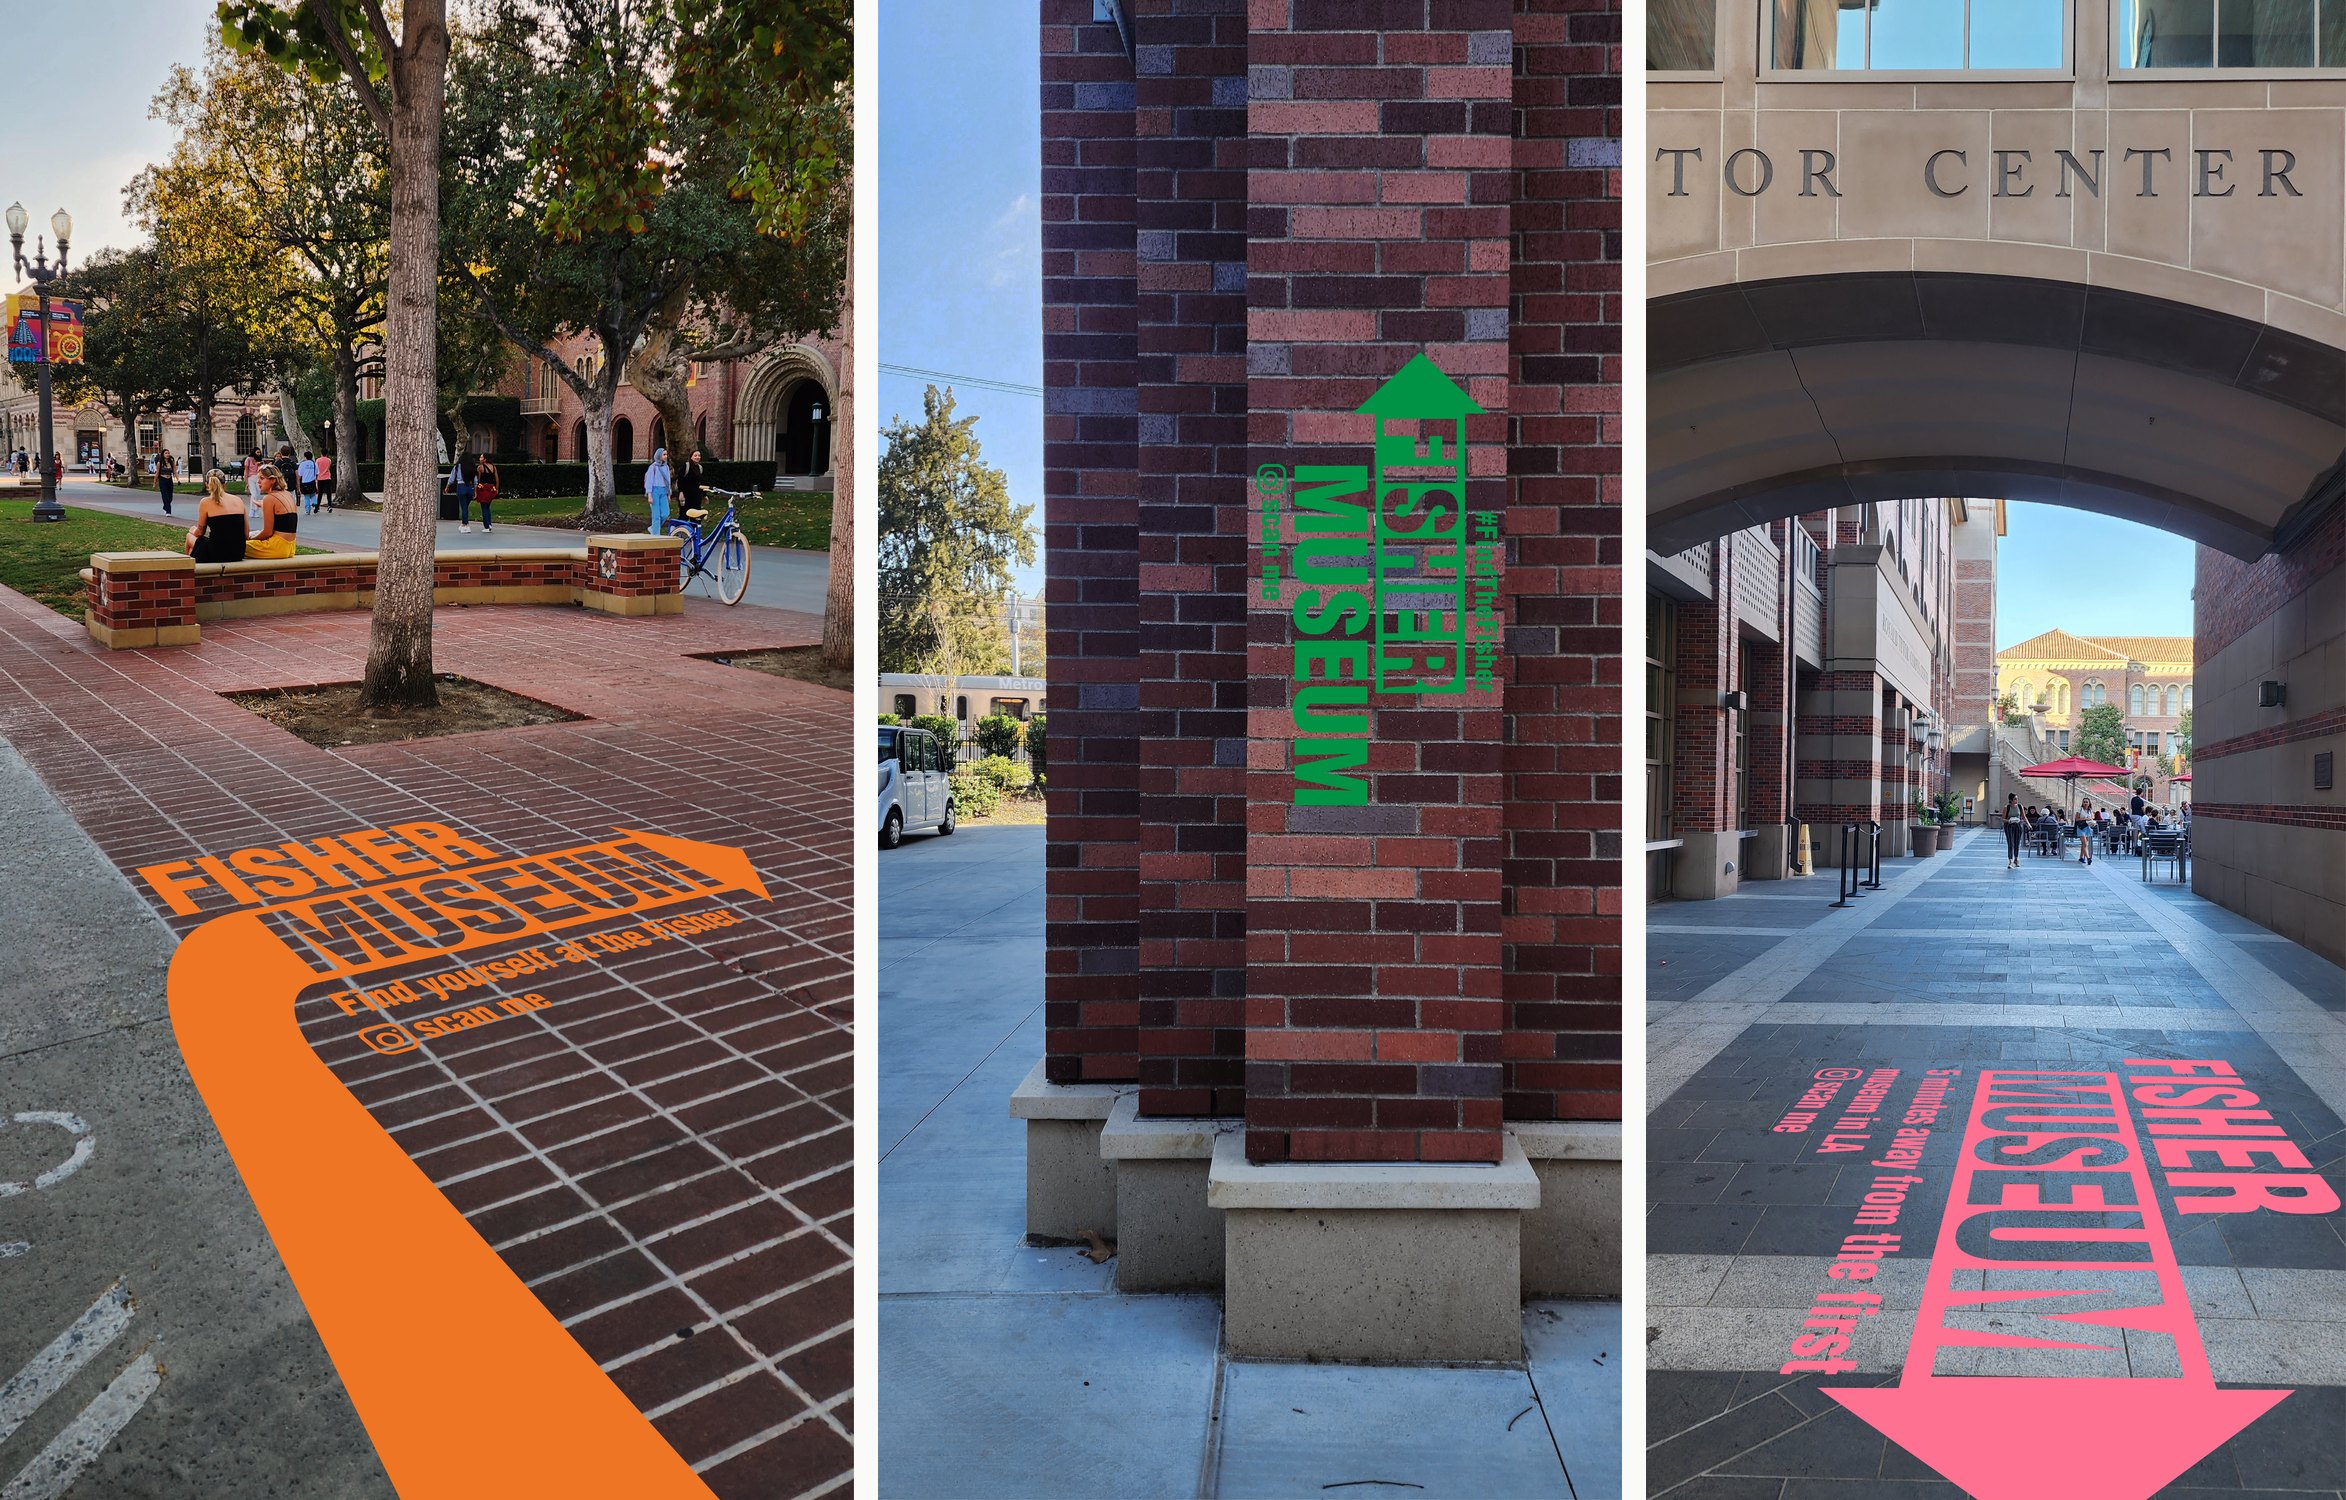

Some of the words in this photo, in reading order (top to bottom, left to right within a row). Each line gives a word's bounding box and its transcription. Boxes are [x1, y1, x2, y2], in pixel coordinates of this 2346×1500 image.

[1655, 147, 1842, 198] TOR
[1924, 147, 2303, 199] CENTER
[1261, 500, 1281, 557] scan
[1382, 418, 1459, 690] FISHER
[1261, 564, 1281, 601] me
[1475, 511, 1498, 693] #FindTheFisher
[1292, 466, 1370, 807] MUSEUM
[999, 677, 1043, 690] Metro
[136, 822, 501, 916] FISHER
[254, 841, 725, 972] MUSEUM
[328, 978, 421, 1016] Find
[417, 948, 558, 1000] yourself
[554, 939, 601, 963] at
[586, 930, 653, 953] the
[638, 909, 743, 941] Fisher
[413, 1006, 502, 1039] scan
[497, 993, 553, 1017] me
[1794, 1081, 1843, 1109] scan
[1845, 1069, 1900, 1113] museum
[1902, 1078, 1956, 1125] minutes
[1773, 1112, 1818, 1133] me
[1816, 1134, 1871, 1154] LA
[1833, 1117, 1881, 1130] in
[2124, 1058, 2341, 1215] FISHER
[1871, 1128, 1931, 1170] away
[1853, 1175, 1923, 1225] from
[1931, 1074, 2186, 1378] MUSEUM
[1828, 1233, 1901, 1280] the
[1780, 1290, 1883, 1375] first
